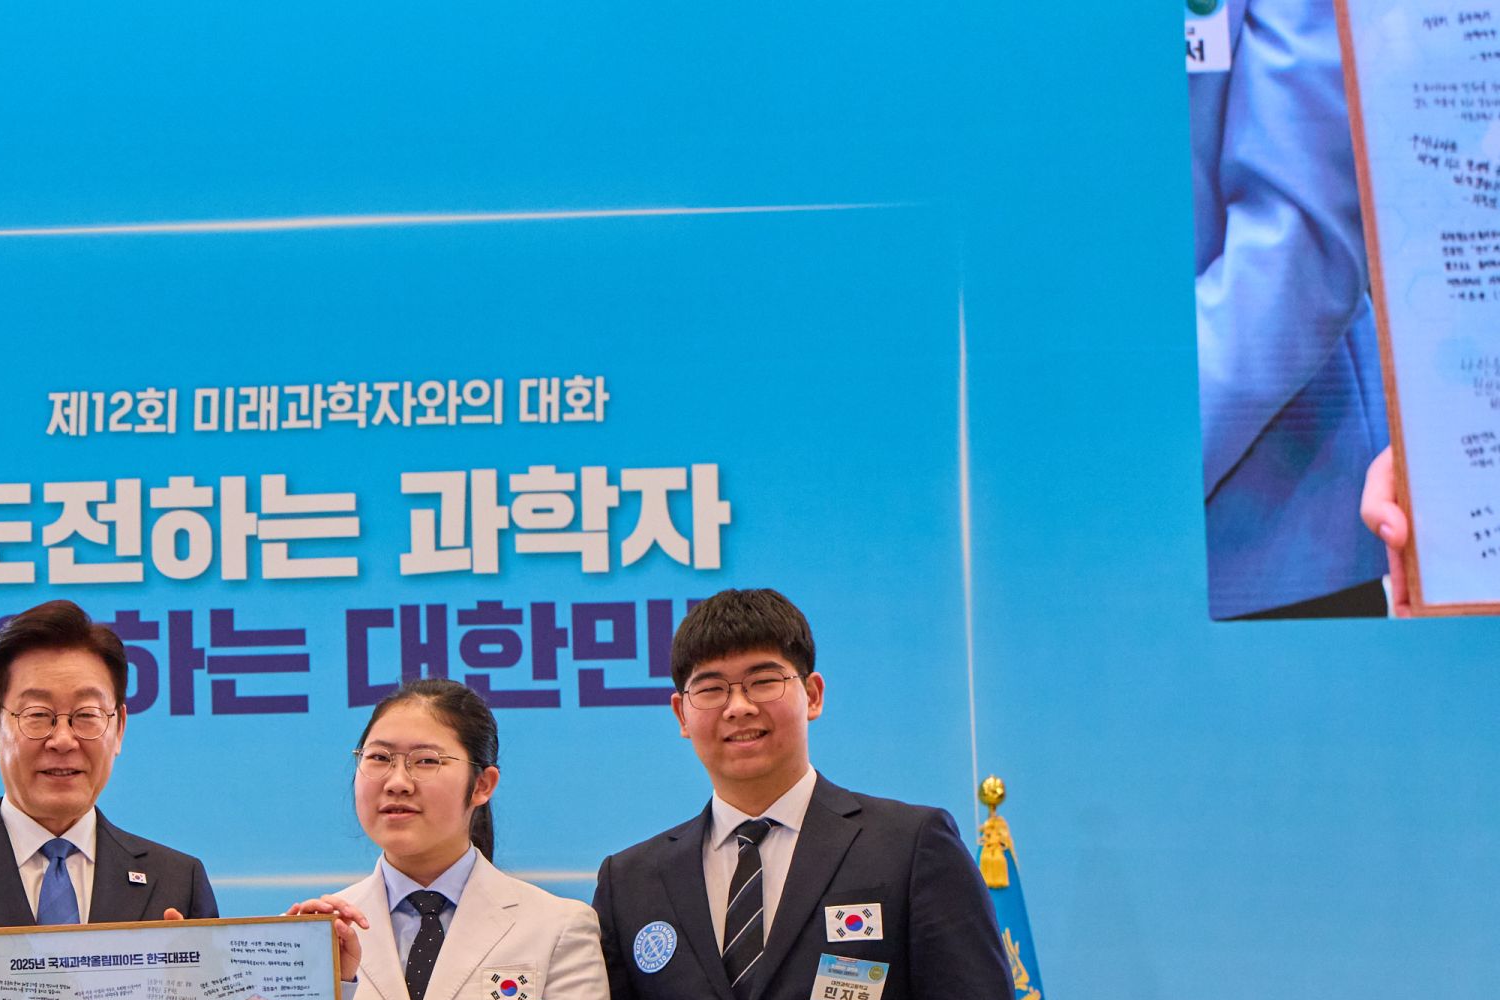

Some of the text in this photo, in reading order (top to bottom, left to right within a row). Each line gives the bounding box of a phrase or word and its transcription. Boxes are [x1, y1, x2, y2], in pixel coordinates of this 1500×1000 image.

[46, 376, 609, 437] 제12회 미래과학자와의 대화
[398, 463, 732, 577] 과학자
[345, 598, 702, 711] 대한민
[10, 951, 200, 971] 2025년 국제과학올림피아드 한국대표단
